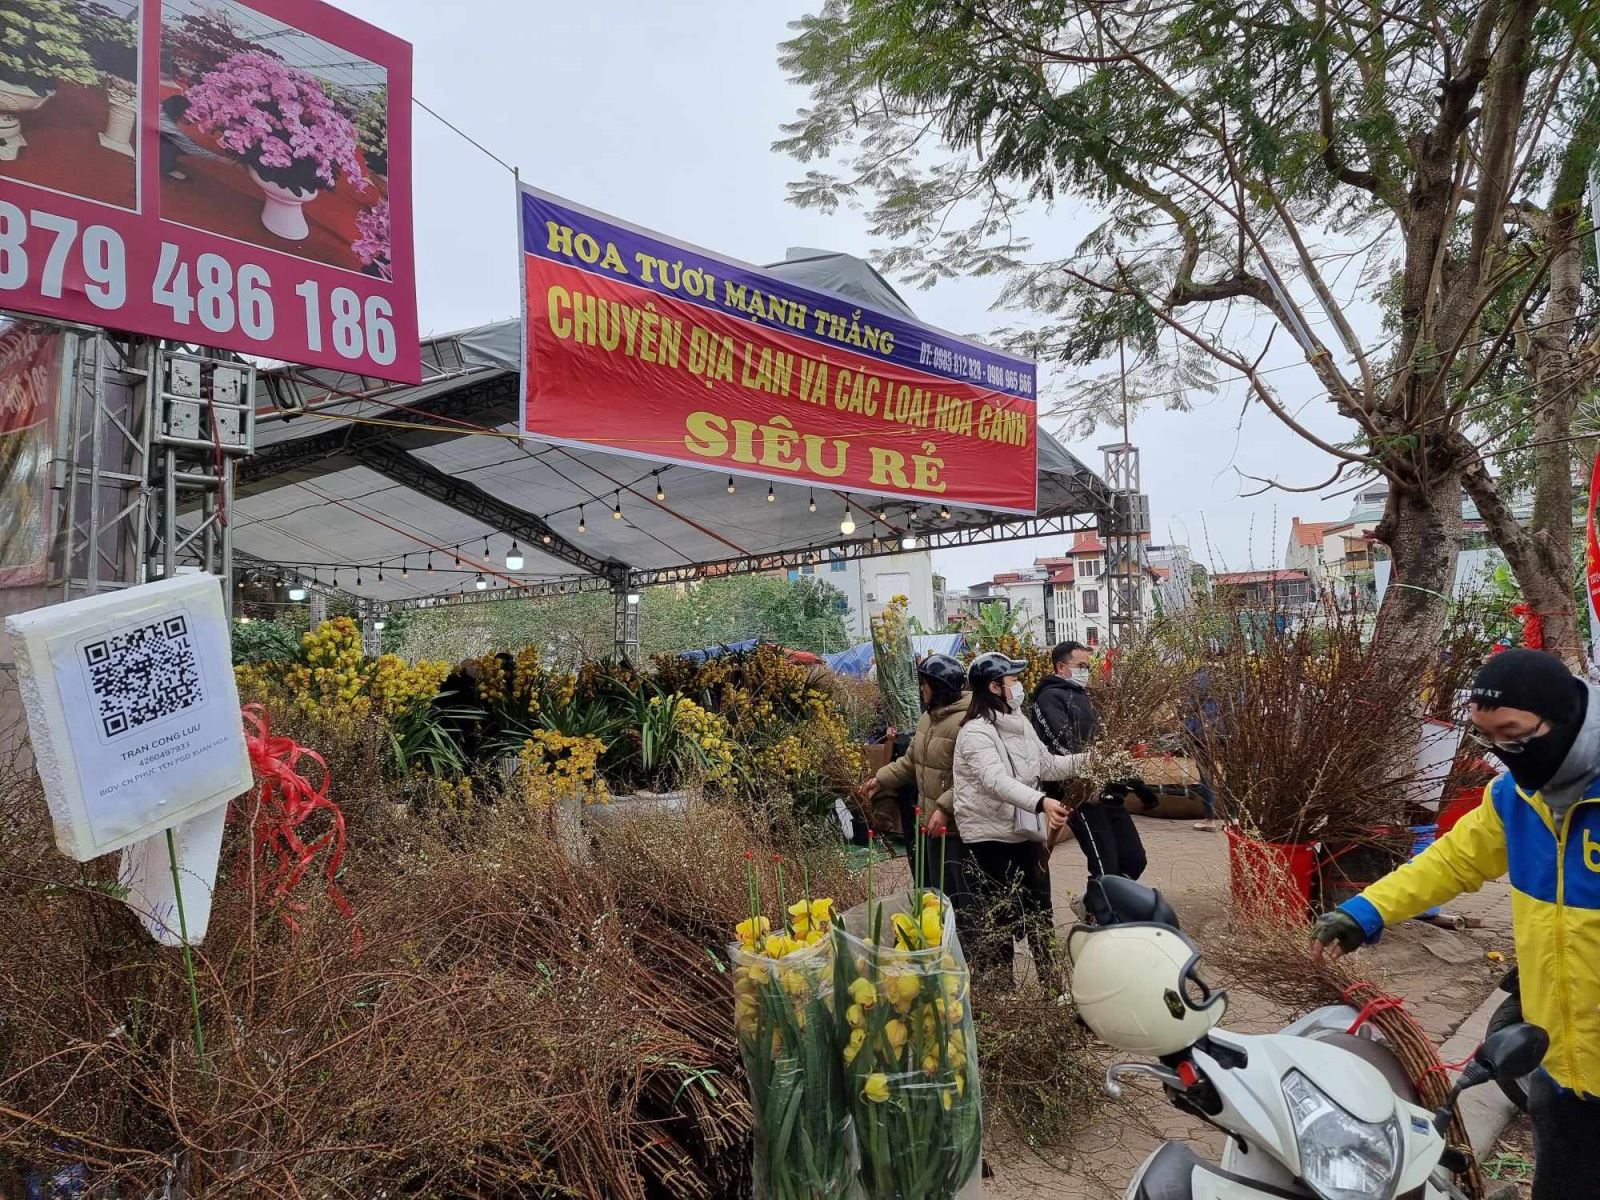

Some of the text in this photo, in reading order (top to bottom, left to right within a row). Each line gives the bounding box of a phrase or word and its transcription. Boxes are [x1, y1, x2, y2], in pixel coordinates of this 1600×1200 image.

[0, 200, 397, 366] 879 486 186
[546, 221, 895, 355] HOA TƯƠI MẠNH THẮNG
[547, 285, 682, 369] CHUYÊN
[688, 325, 734, 389] ĐỊA
[741, 342, 794, 397] LAN
[799, 354, 829, 406] VÀ
[834, 365, 881, 417] CÁC
[883, 381, 932, 435] LOẠI
[934, 393, 972, 437] HOA
[1005, 369, 1018, 391] 965
[684, 411, 947, 493] SIÊU RẺ
[1472, 688, 1502, 698] SWAT
[120, 723, 201, 761] TRAN CONG LUU
[134, 767, 157, 783] PHUC
[158, 760, 174, 771] YEN
[175, 753, 191, 766] PGD
[192, 744, 213, 757] XUAN
